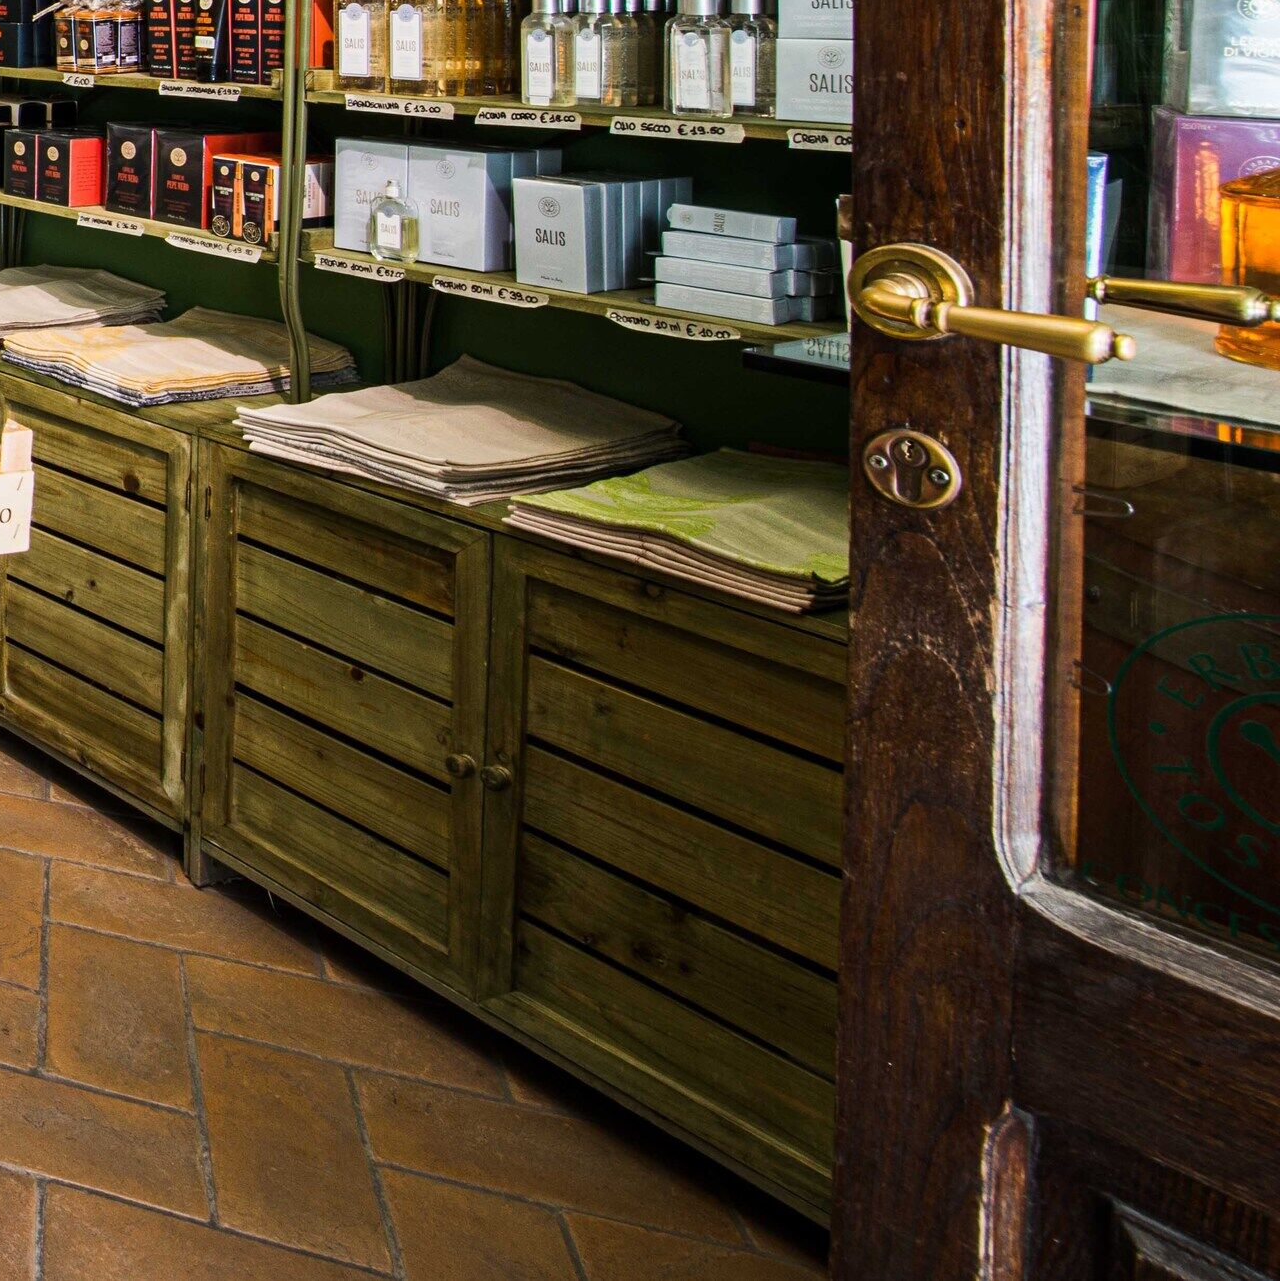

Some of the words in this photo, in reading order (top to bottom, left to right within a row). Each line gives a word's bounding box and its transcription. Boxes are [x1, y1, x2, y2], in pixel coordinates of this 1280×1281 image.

[344, 37, 365, 49] SALIS
[396, 40, 416, 52] SALIS
[530, 62, 550, 73] SALIS
[577, 60, 598, 72] SALIS
[809, 73, 853, 94] SALIS
[641, 124, 671, 134] SECCO
[430, 198, 460, 218] SALIS
[535, 228, 566, 247] SALIS
